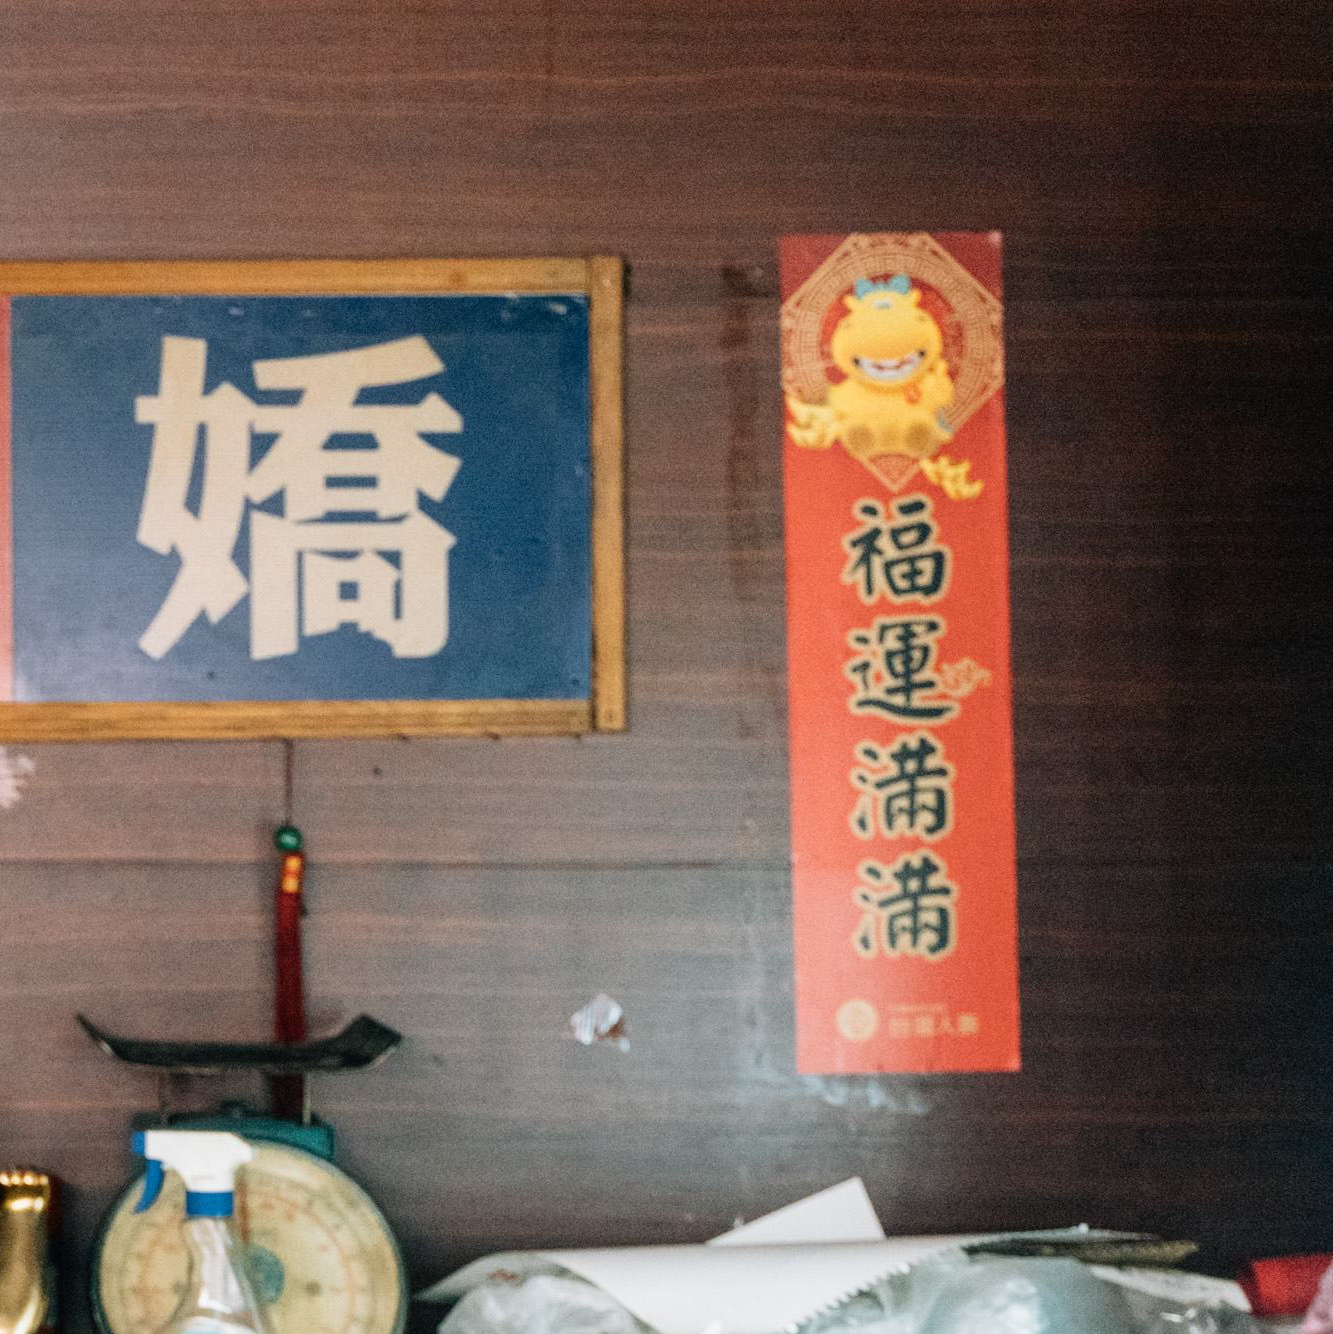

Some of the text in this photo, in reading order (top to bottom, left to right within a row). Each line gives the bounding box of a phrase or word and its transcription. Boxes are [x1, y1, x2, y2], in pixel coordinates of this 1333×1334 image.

[135, 334, 464, 660] 嬌
[849, 498, 958, 957] 福運滿滿
